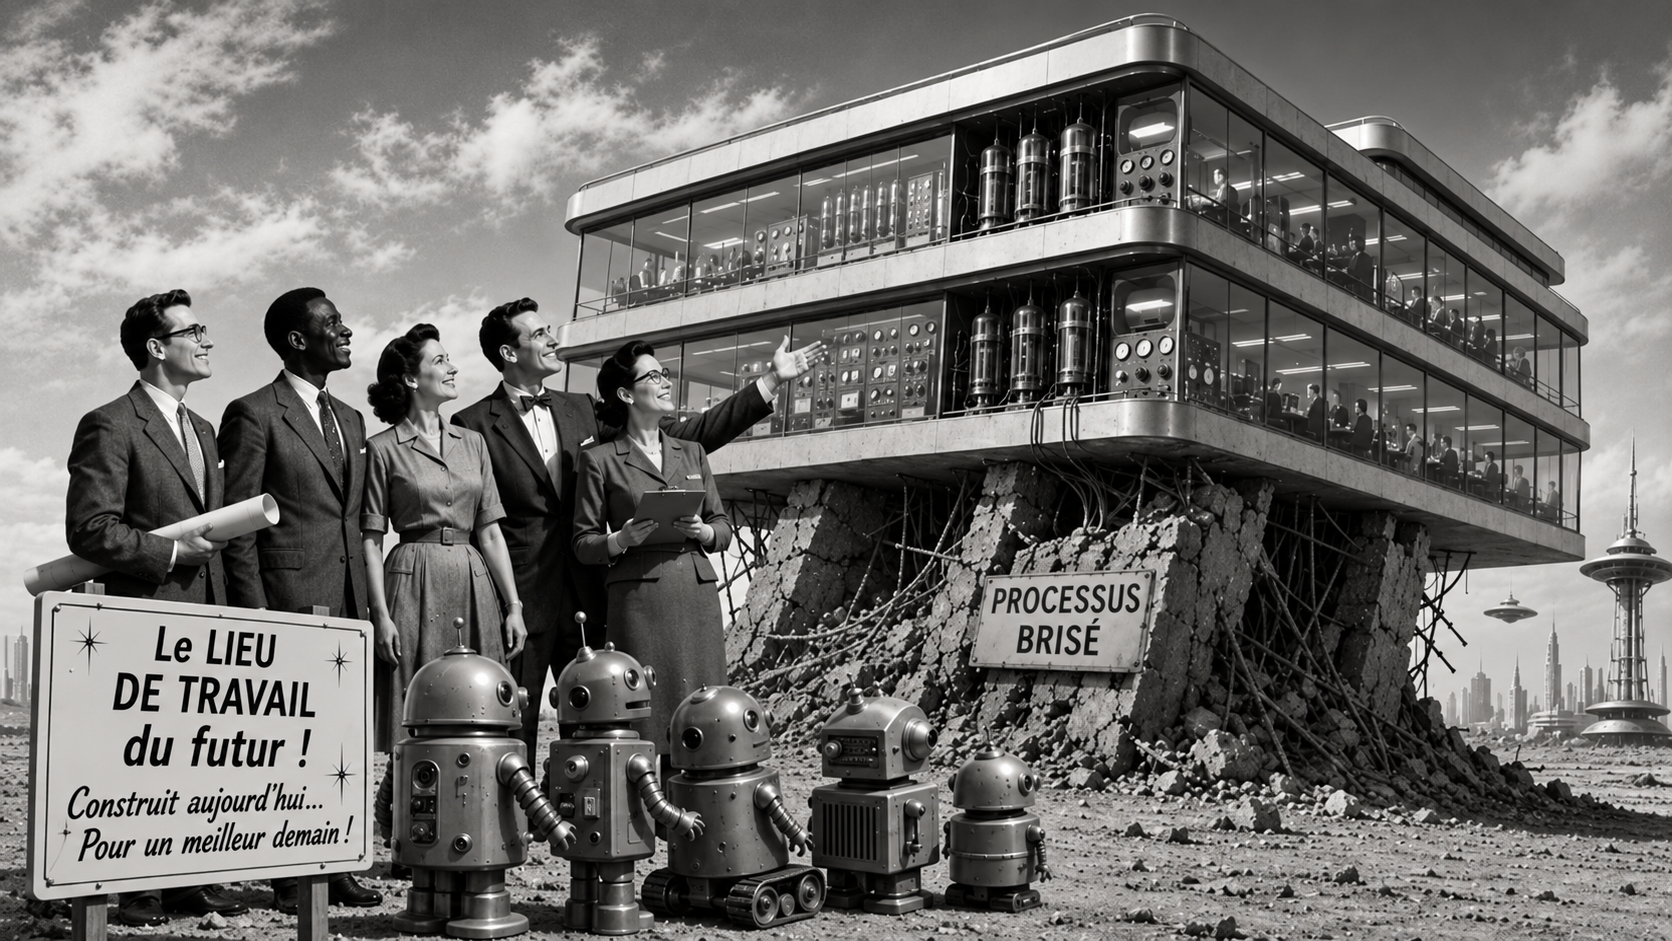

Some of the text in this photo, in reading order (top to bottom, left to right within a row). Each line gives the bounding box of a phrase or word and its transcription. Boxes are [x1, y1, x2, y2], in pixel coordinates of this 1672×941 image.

[991, 583, 1140, 614] PROCESSUS
[155, 626, 276, 668] Le LIEU
[1017, 618, 1100, 656] BRISÉ
[113, 672, 315, 717] DE TRAVAIL
[124, 724, 311, 767] du futur !
[68, 783, 322, 823] Construit aujourd'hui...
[78, 816, 353, 861] Pour un meilleur demain !
